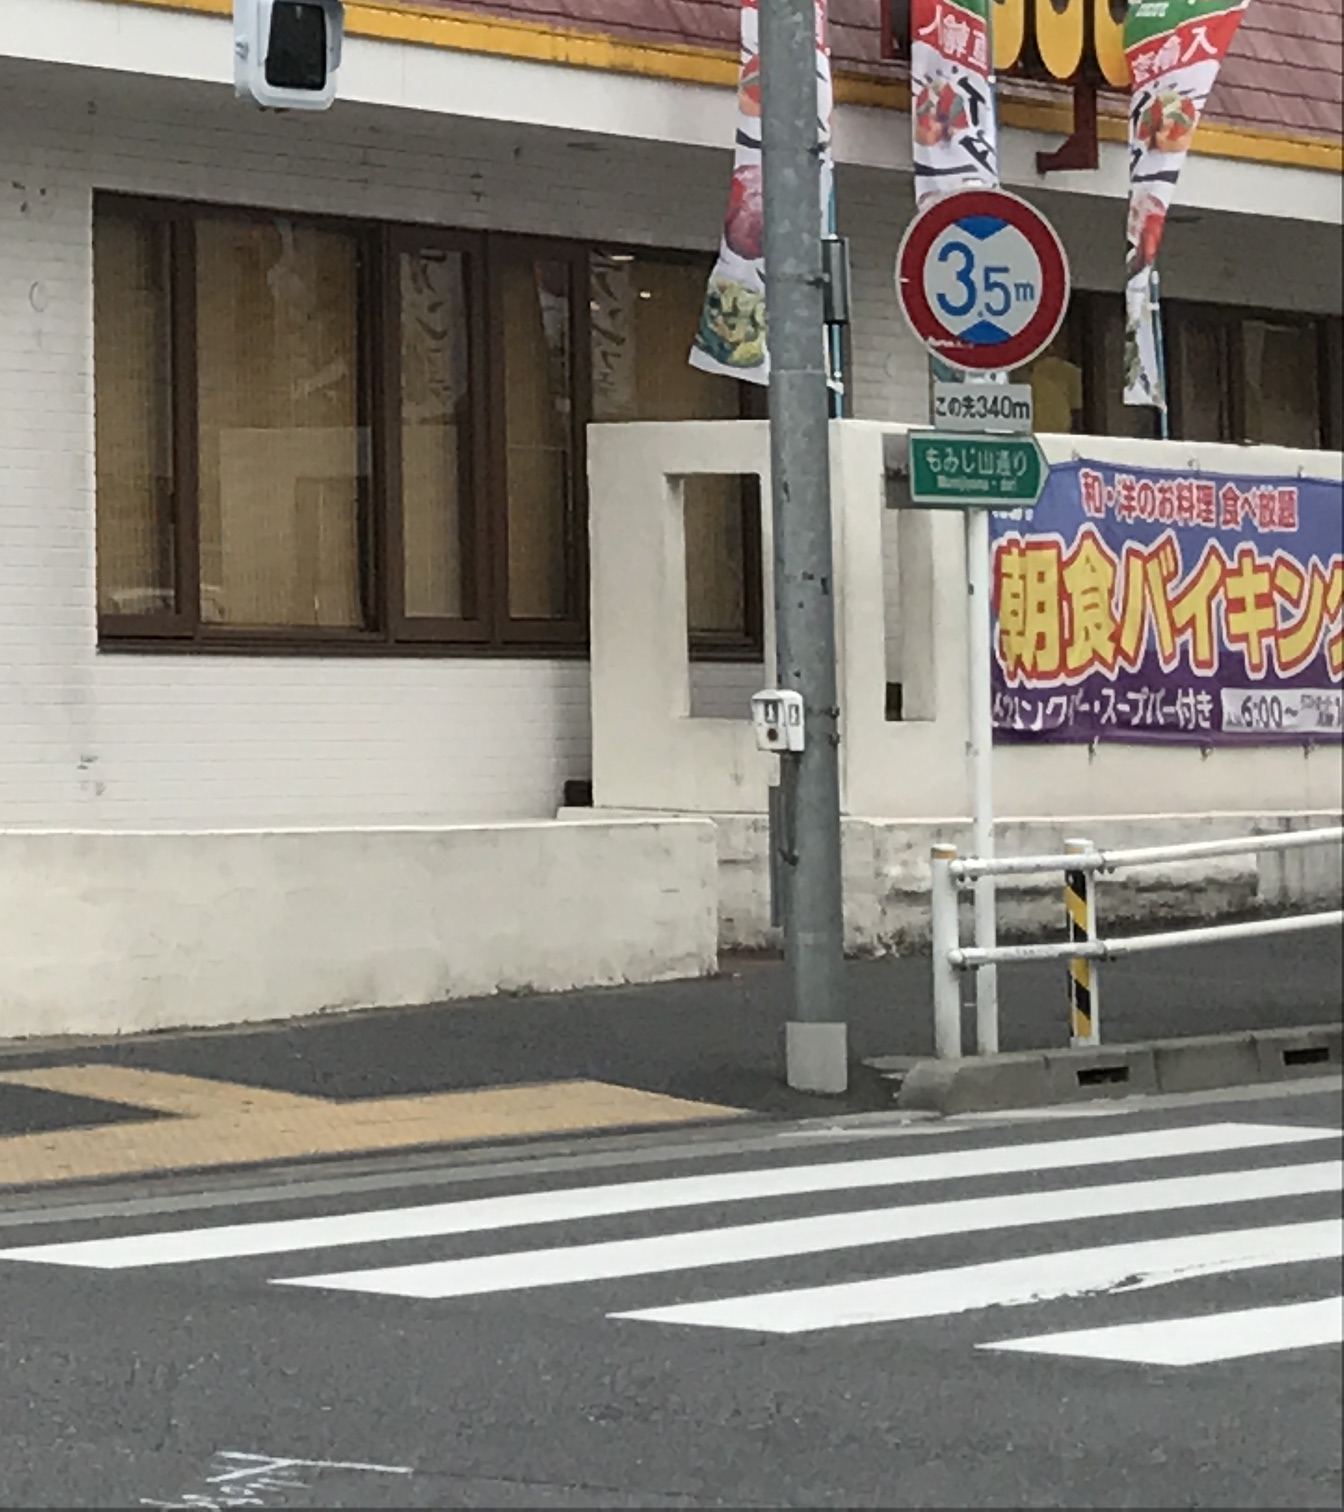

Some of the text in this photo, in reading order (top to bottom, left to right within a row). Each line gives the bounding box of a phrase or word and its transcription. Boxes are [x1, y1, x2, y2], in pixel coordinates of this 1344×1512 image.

[935, 394, 1031, 420] この先340m
[925, 448, 1027, 476] もみじ山通り
